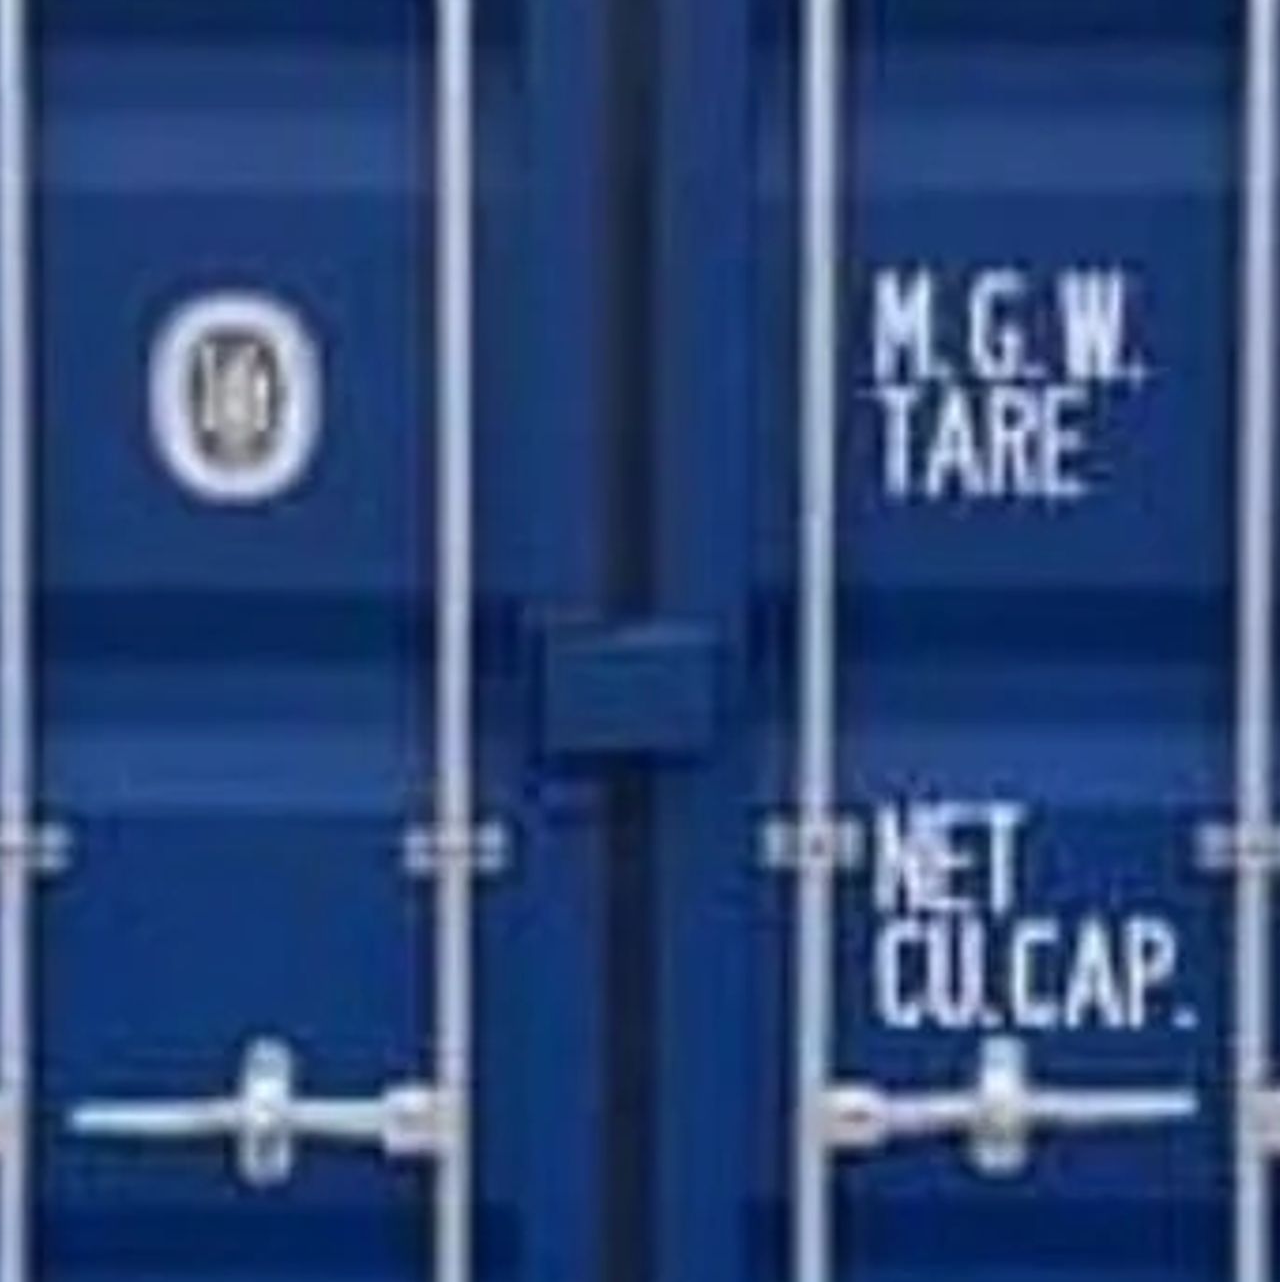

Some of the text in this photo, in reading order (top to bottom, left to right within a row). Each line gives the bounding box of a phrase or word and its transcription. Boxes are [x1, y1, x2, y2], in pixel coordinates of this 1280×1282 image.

[873, 387, 1090, 498] TARE
[874, 802, 1027, 913] NET
[876, 917, 1198, 1028] CU.CAP.
